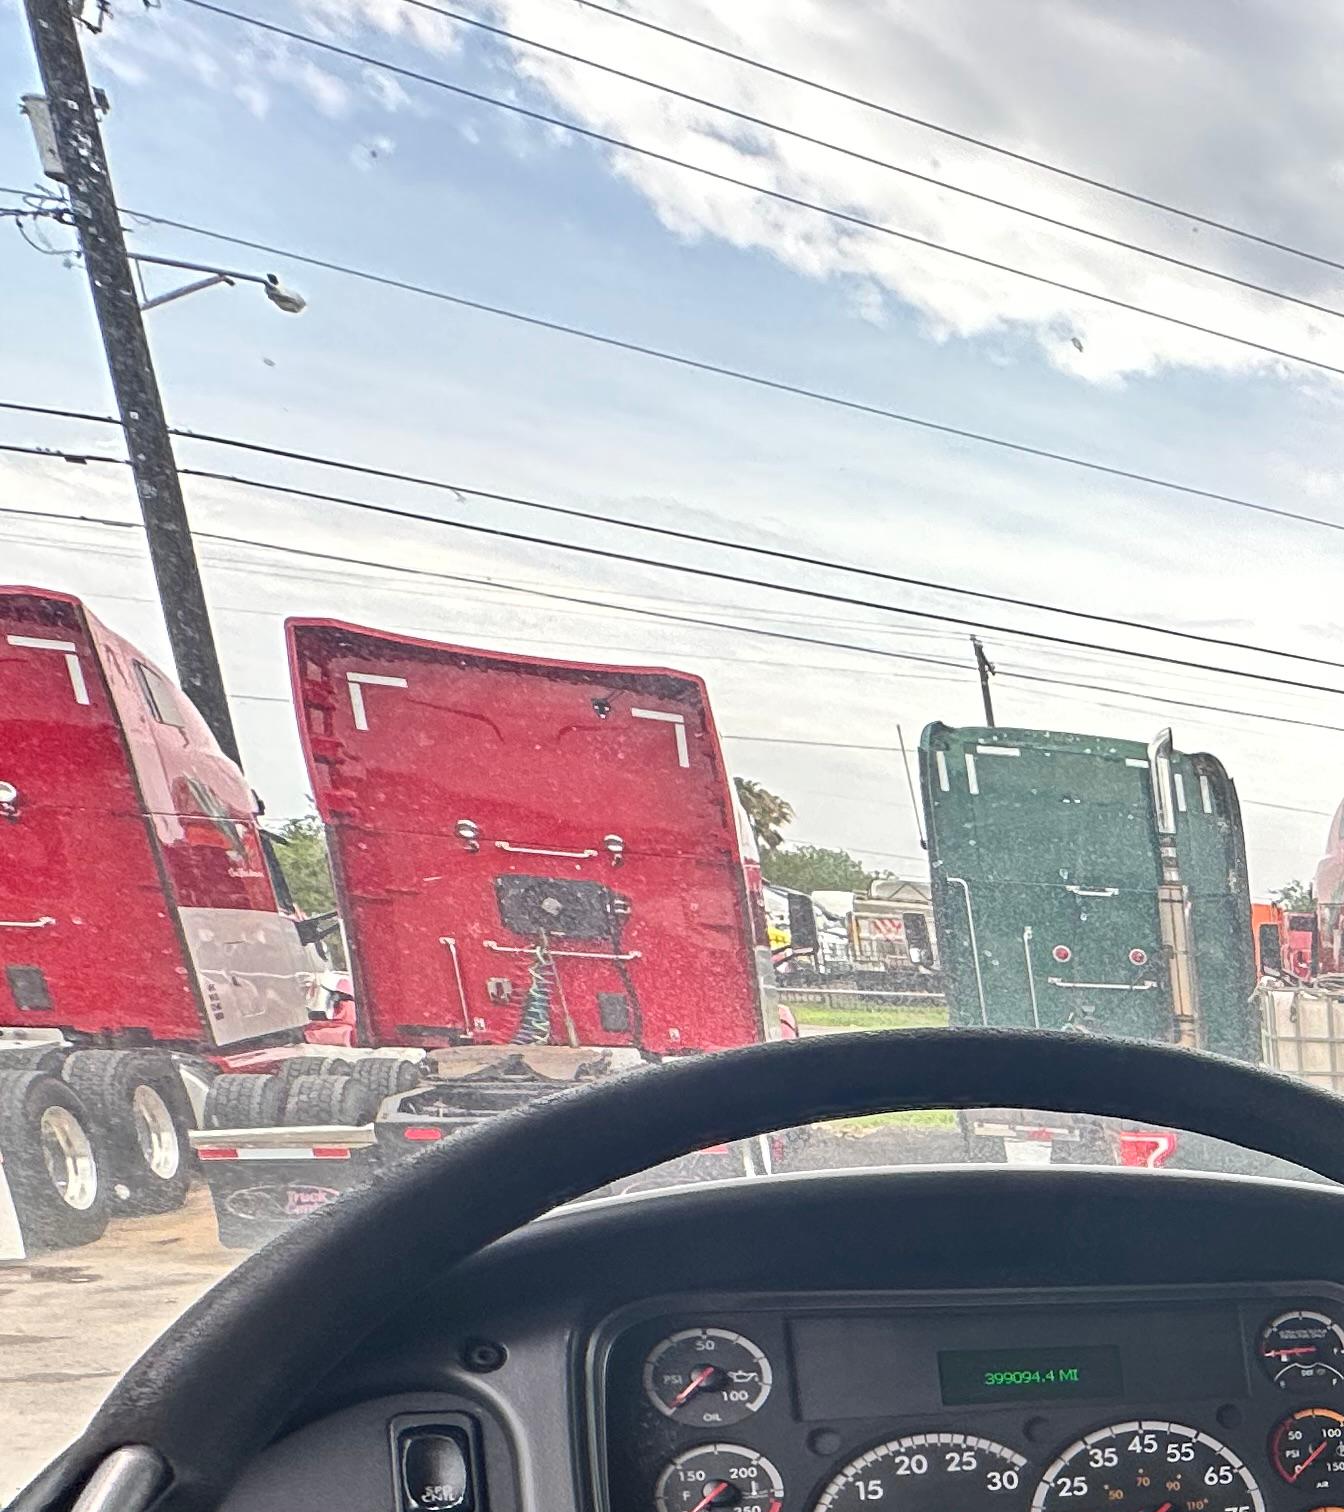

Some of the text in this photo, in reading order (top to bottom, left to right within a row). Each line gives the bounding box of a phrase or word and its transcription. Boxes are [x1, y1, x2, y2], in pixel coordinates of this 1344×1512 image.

[696, 1340, 716, 1351] 50
[984, 1368, 1080, 1386] 399094.4 MI
[722, 1390, 749, 1401] 100
[702, 1413, 722, 1422] OIL
[1288, 1430, 1303, 1440] 50
[1322, 1428, 1342, 1438] 100
[1128, 1434, 1158, 1453] 45
[1089, 1447, 1118, 1468] 35
[1166, 1442, 1195, 1462] 55
[1285, 1449, 1300, 1458] PSI
[894, 1454, 928, 1475] 20
[945, 1451, 977, 1472] 25
[679, 1470, 706, 1481] 150
[729, 1467, 757, 1479] 200
[1204, 1466, 1233, 1486] 65
[986, 1470, 1019, 1491] 30
[1136, 1477, 1150, 1487] 70
[855, 1479, 884, 1501] 15
[1056, 1476, 1088, 1497] 25
[1166, 1481, 1181, 1492] 90
[682, 1490, 691, 1501] F
[1108, 1489, 1124, 1500] 50
[1187, 1500, 1204, 1511] 110
